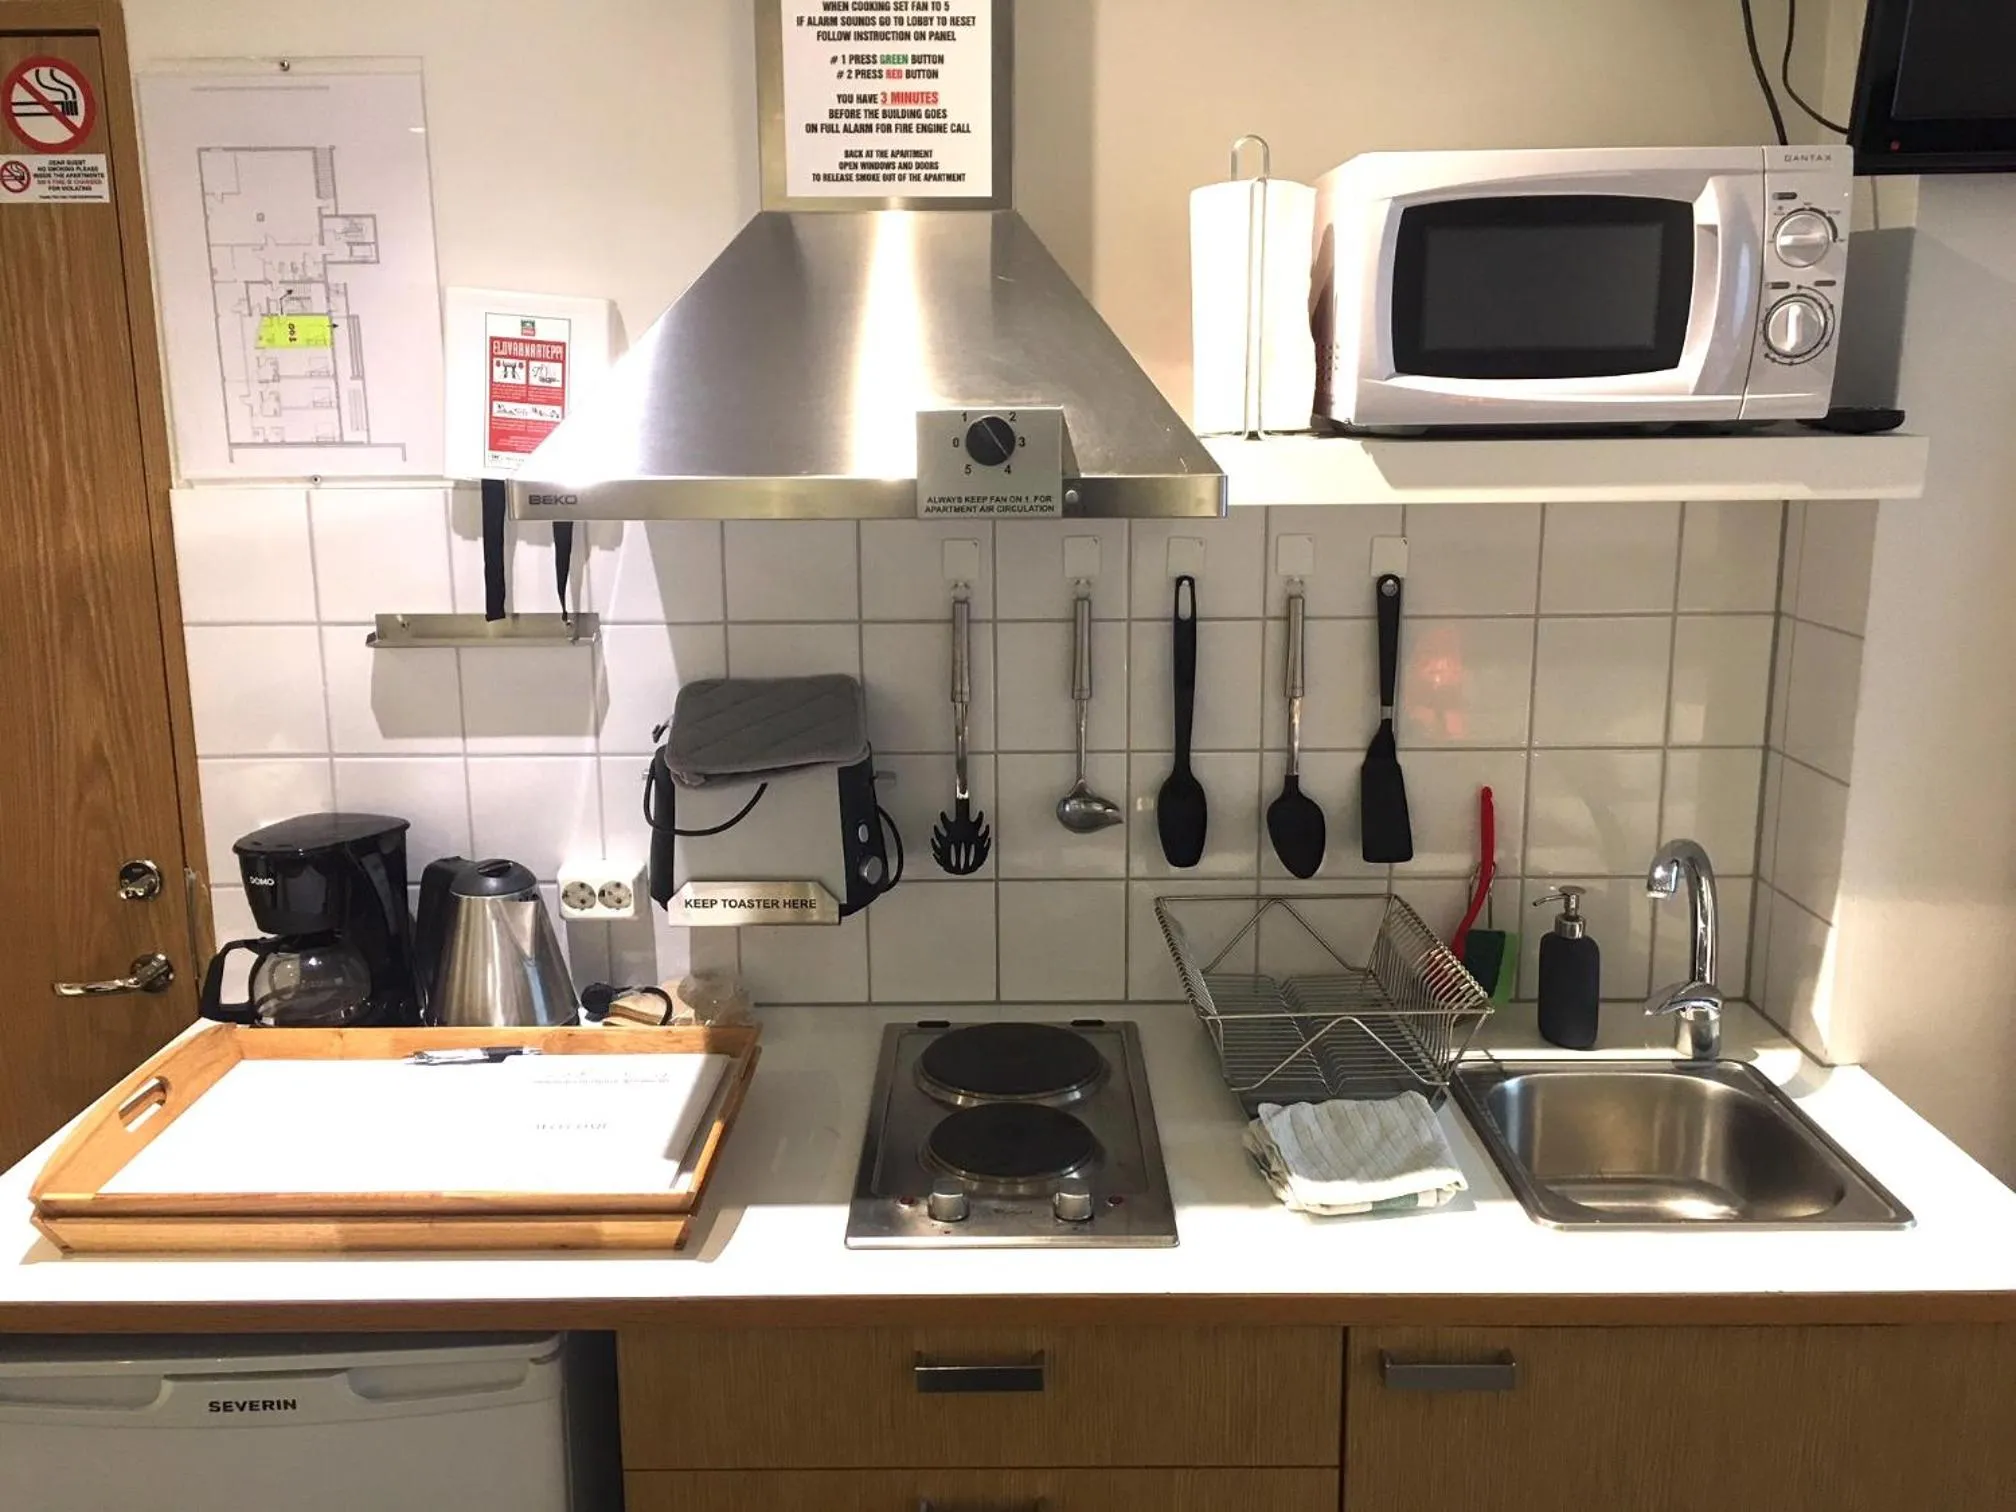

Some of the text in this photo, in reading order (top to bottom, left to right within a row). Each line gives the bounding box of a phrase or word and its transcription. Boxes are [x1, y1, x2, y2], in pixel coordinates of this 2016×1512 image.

[823, 1, 950, 12] WHEN COOKING SET FAN TO 5
[797, 16, 976, 27] IF ALARM SOUNDS GO TO LOBBY TO RESET
[817, 30, 956, 41] FOLLOW INSTRUCTION ON PANEL
[830, 54, 944, 65] # 1 PRESS GREEN BUTTON
[837, 69, 938, 79] # 2 PRESS RED BUTTON
[837, 92, 939, 104] YOU HAVE 3 MINUTES
[829, 109, 947, 119] BEFORE THE BUILDING GOES
[805, 123, 971, 134] ON FULL ALARM FOR FIRE ENGINE CALL
[844, 149, 932, 158] BACK AT THE APARTMENT
[839, 161, 939, 170] OPEN WINDOWS AND DOORS
[812, 173, 965, 182] TO RELEASE SMOKE OUT OF THE APARTMENT
[962, 412, 1017, 422] 1 2
[952, 436, 1026, 448] 0 3
[964, 464, 1012, 475] 5 4
[528, 495, 578, 505] BEKO
[927, 496, 963, 504] ALWAYS
[1034, 495, 1052, 503] FOR
[925, 504, 1055, 513] APARTMENT AIR CIRCULATION
[250, 876, 275, 886] DOMO
[684, 899, 817, 909] KEEP TOASTER HERE
[208, 1399, 297, 1412] SEVERIN
